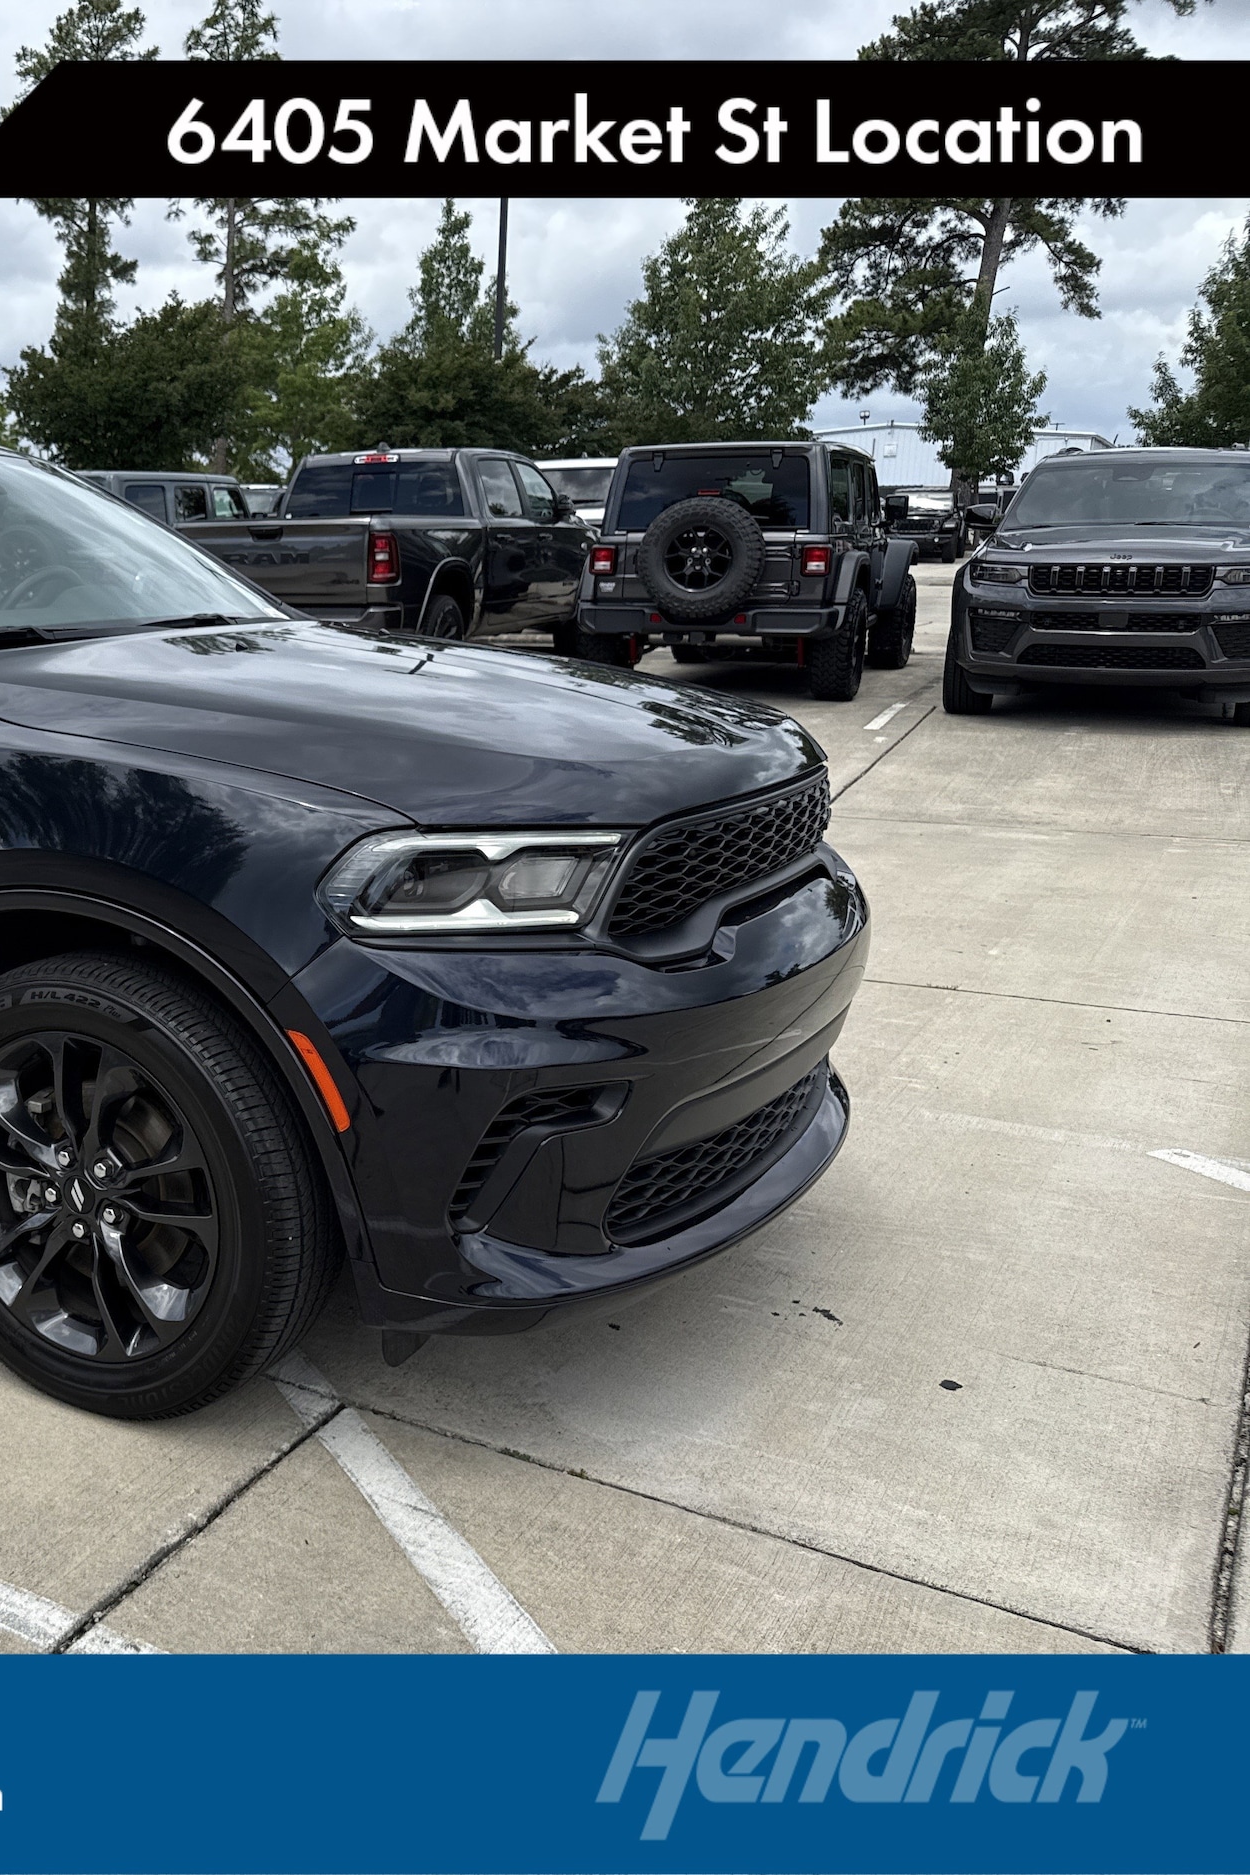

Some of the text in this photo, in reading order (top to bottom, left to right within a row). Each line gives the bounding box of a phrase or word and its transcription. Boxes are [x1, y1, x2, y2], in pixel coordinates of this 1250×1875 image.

[222, 552, 310, 564] RAM
[1109, 553, 1133, 561] Jeep
[63, 993, 102, 1010] 422
